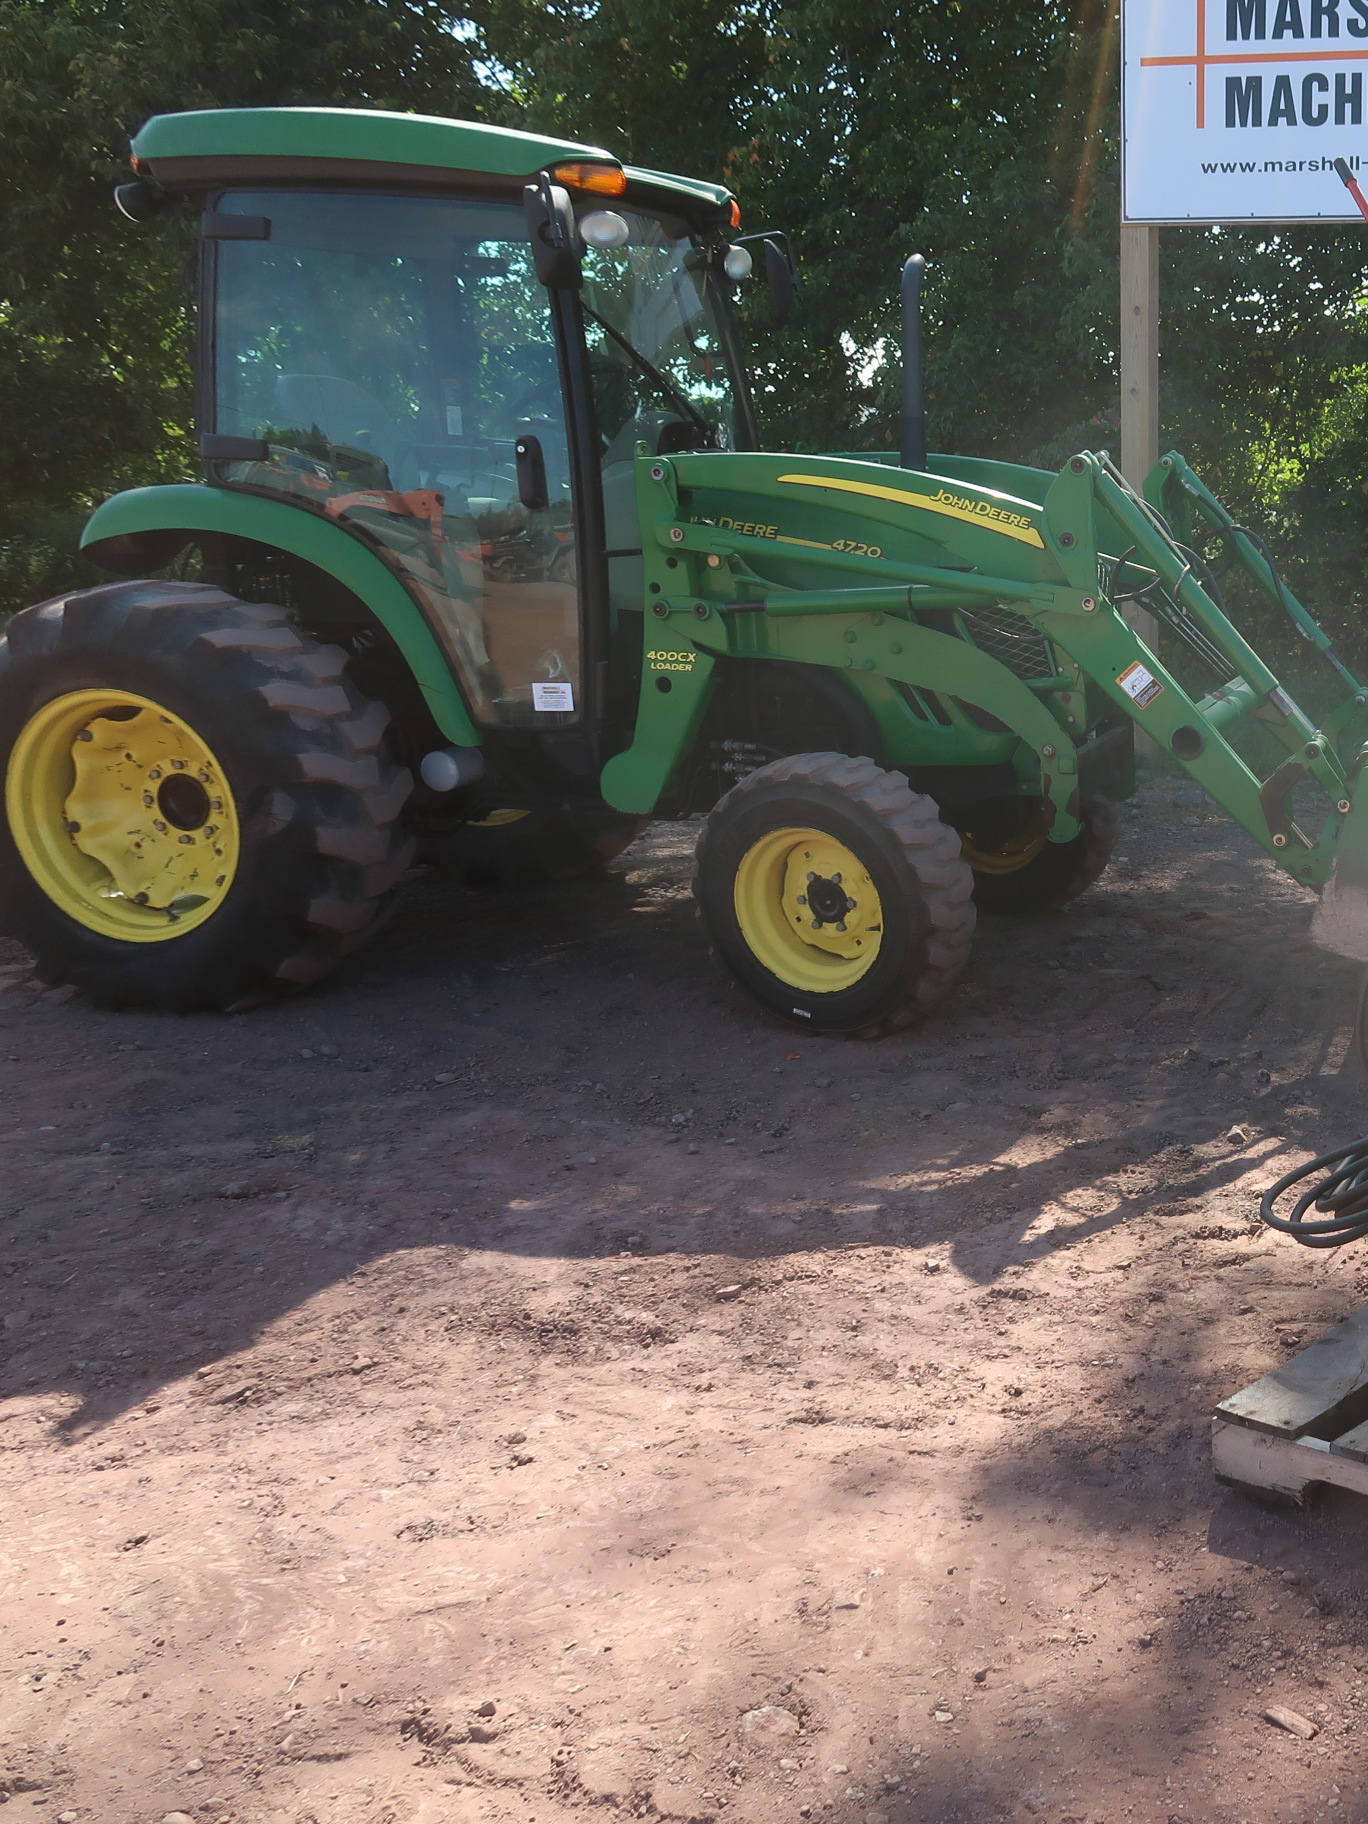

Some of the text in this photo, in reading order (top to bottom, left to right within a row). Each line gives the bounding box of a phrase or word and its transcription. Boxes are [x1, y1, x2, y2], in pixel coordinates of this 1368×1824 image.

[930, 489, 1032, 529] JOHN DEERE
[832, 539, 882, 558] 4720
[646, 650, 697, 662] 400CX
[650, 662, 693, 671] LOADER
